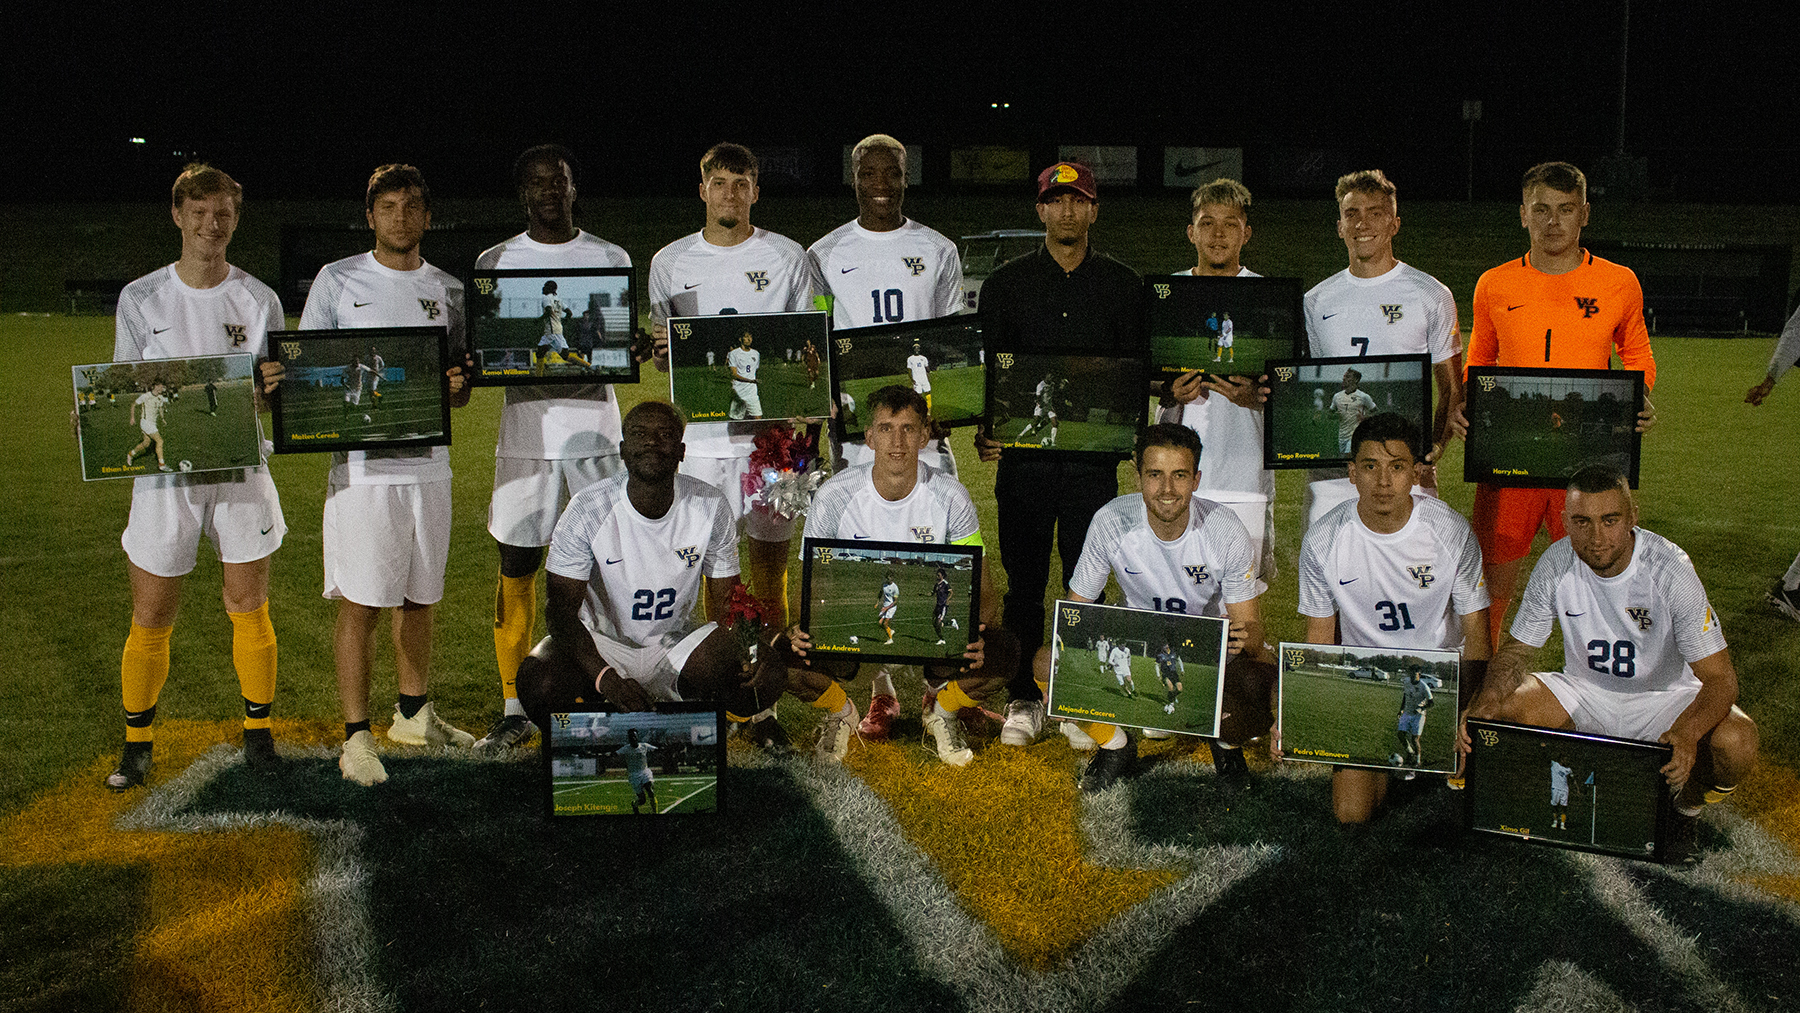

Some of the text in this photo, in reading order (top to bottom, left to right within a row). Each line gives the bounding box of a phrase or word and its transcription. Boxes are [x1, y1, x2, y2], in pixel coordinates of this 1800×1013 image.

[902, 257, 925, 276] WP
[746, 271, 769, 291] WP
[418, 298, 441, 320] WP
[871, 288, 904, 323] 10
[1381, 304, 1402, 324] WP
[1574, 296, 1600, 318] WP
[224, 325, 247, 346] WP
[1545, 329, 1552, 362] 1
[710, 410, 726, 418] Koch
[1277, 453, 1294, 461] Tiago
[1493, 468, 1511, 476] Harry
[675, 547, 701, 568] WP
[1182, 565, 1209, 585] WP
[1406, 565, 1435, 588] WP
[631, 588, 677, 621] 22
[1375, 601, 1415, 631] 31
[1625, 608, 1653, 631] WP
[1587, 639, 1635, 678] 28
[1058, 704, 1116, 718] Alejandro Caceres
[1293, 748, 1350, 759] Pedro Villanueva
[555, 803, 582, 813] Joseph
